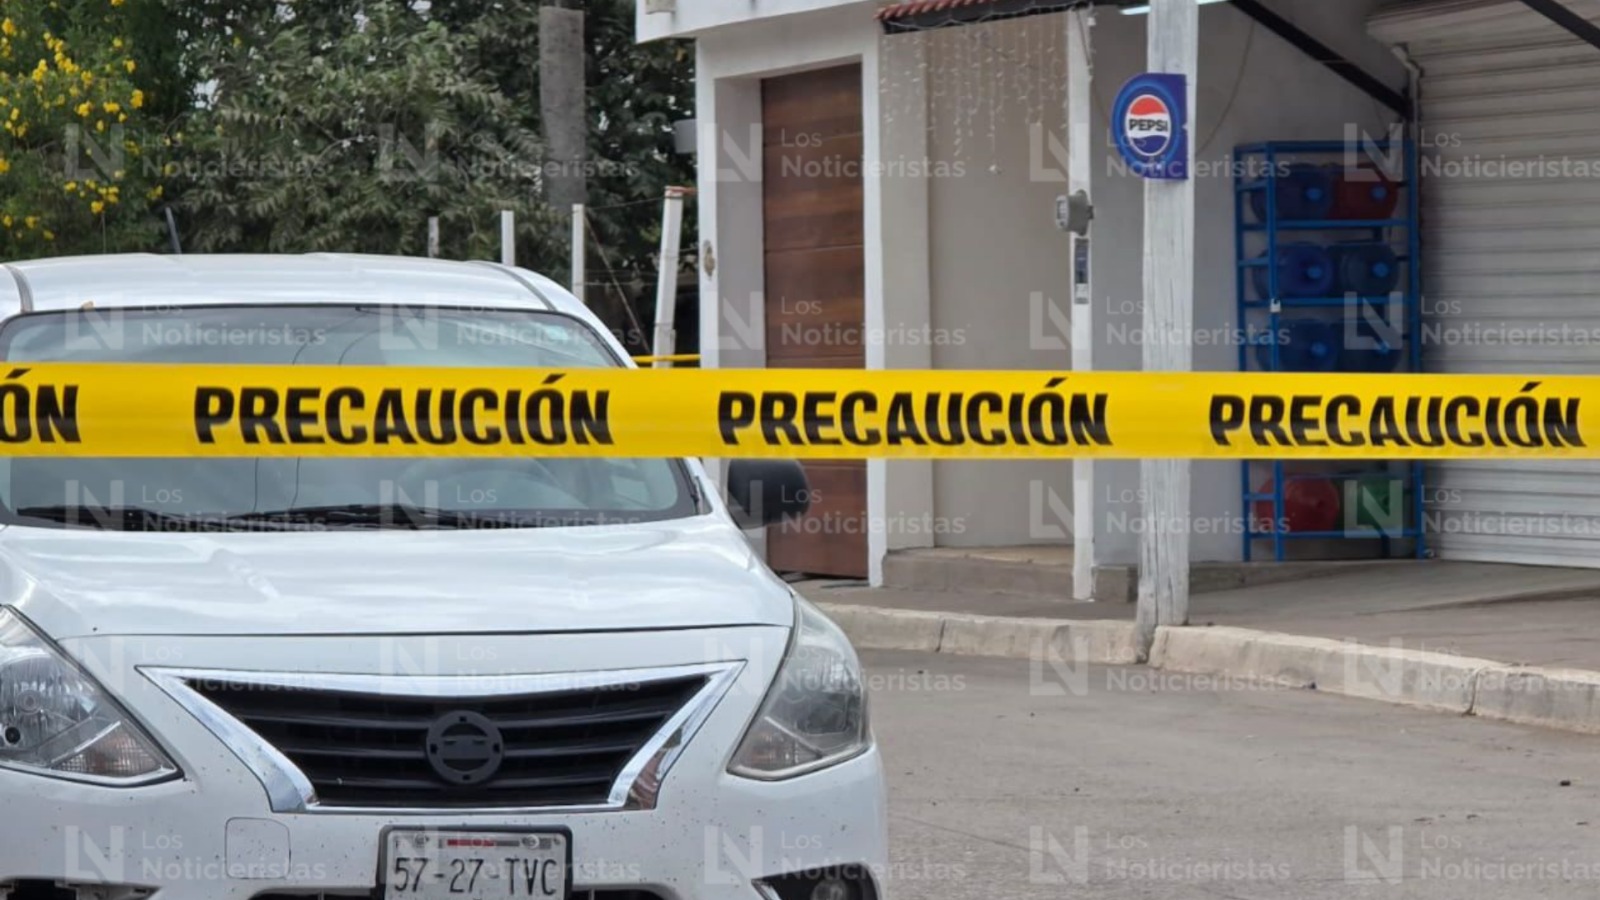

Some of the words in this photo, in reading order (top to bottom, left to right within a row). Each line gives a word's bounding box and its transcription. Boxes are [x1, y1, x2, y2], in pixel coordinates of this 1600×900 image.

[1129, 119, 1168, 131] PEPSI
[194, 373, 614, 445] PRECAUCIÓN
[718, 377, 1113, 446] PRECAUCIÓN
[1209, 382, 1586, 447] PRECAUCIÓN
[394, 857, 557, 896] 57-27-TVC
